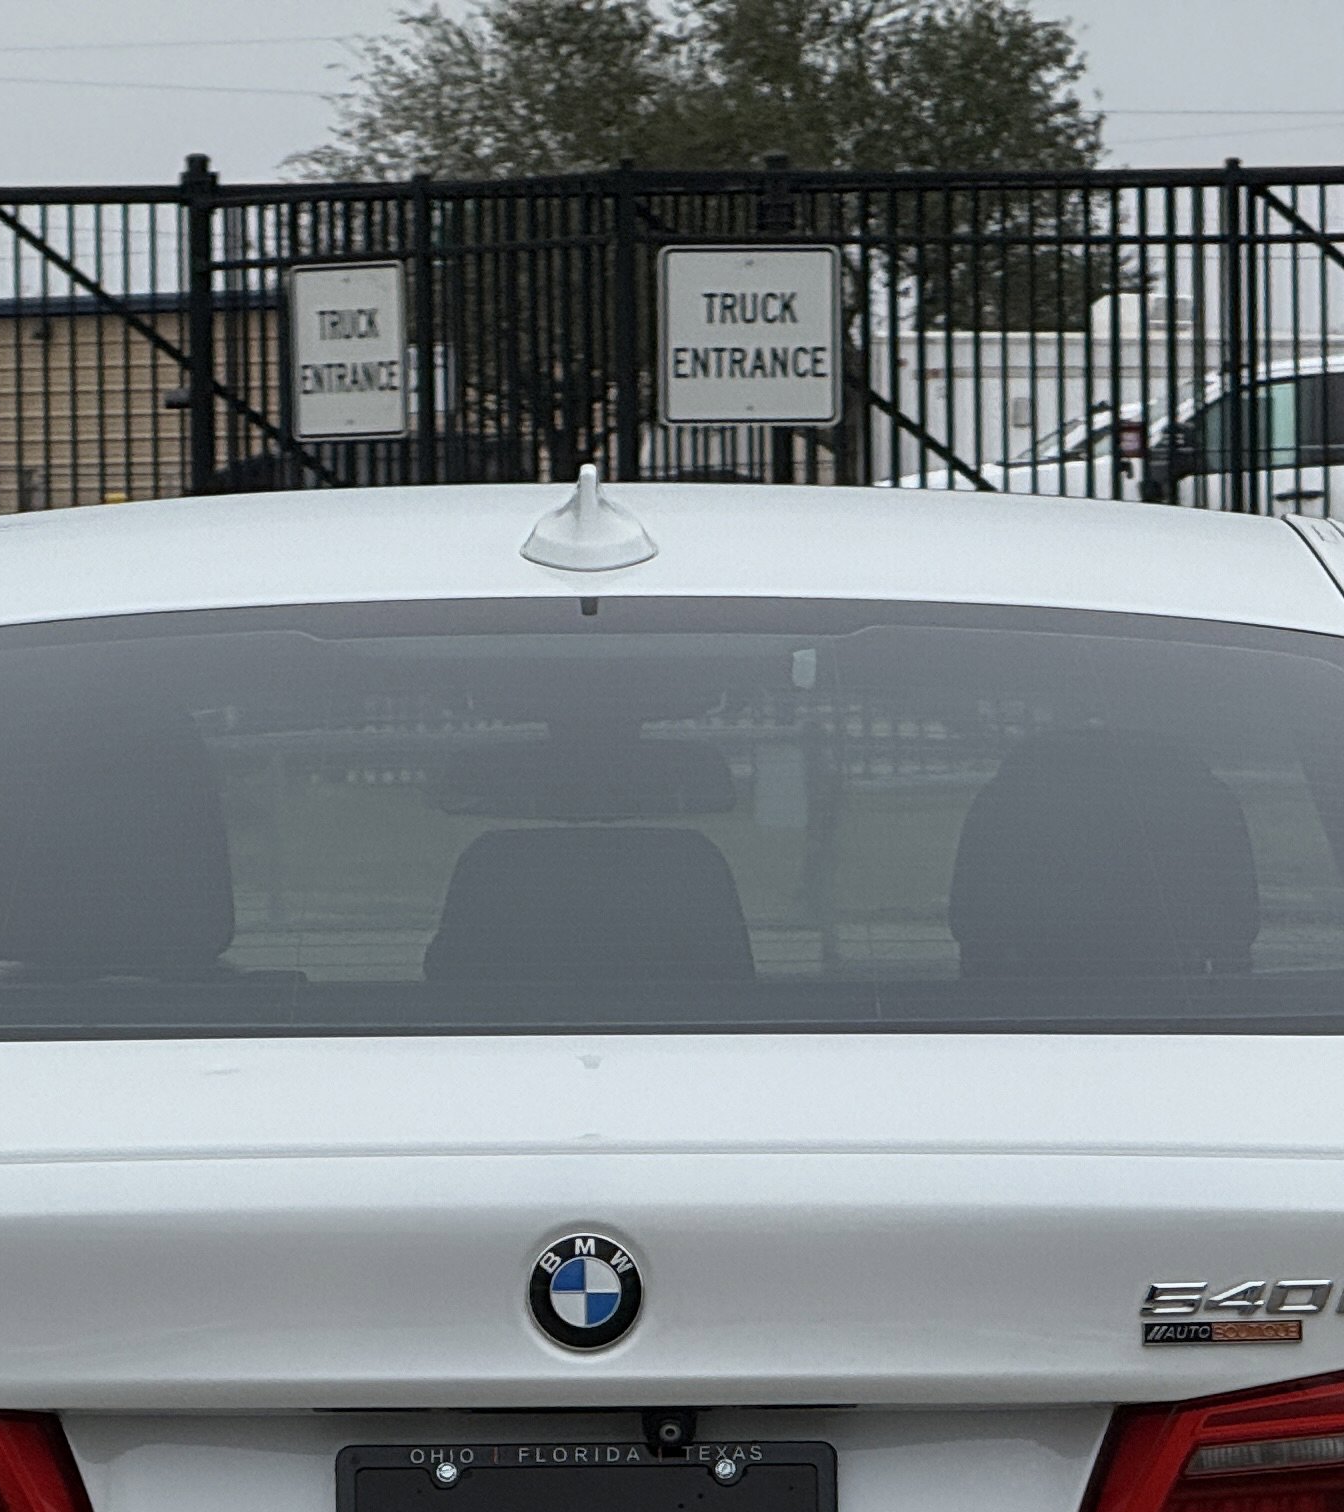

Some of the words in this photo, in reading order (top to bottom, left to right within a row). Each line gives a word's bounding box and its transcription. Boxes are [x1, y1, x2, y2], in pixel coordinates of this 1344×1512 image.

[316, 307, 382, 342] TRUCK
[702, 291, 798, 325] TRUCK
[300, 359, 400, 395] ENTRANCE
[672, 346, 829, 380] ENTRANCE
[539, 1238, 634, 1274] BMW
[410, 1448, 474, 1465] OHIO
[518, 1446, 640, 1464] FLORIDA
[682, 1445, 764, 1463] TEXAS
